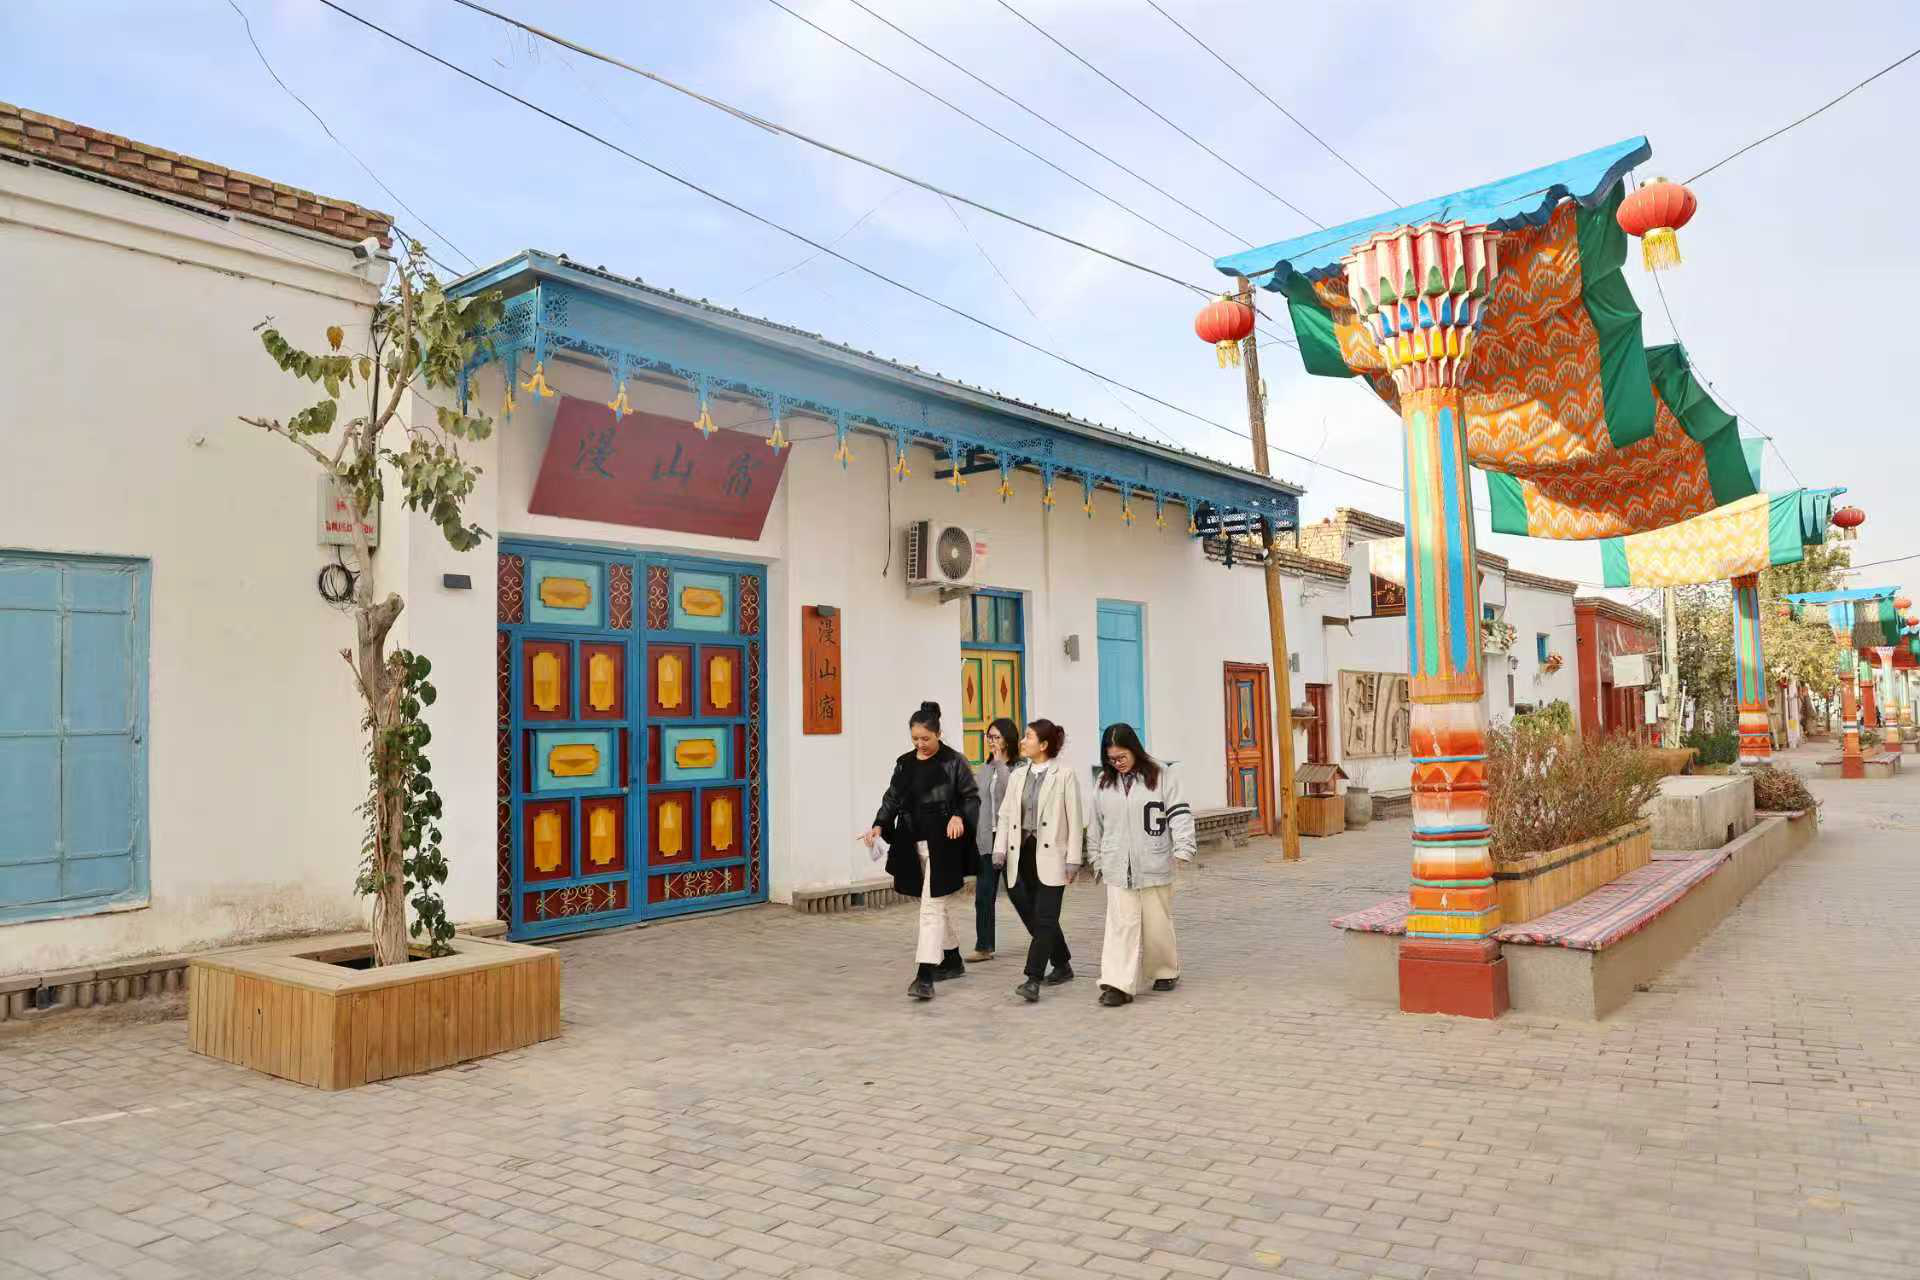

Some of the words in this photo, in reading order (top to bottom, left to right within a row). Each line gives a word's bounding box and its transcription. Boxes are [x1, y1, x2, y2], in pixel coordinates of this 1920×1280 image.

[818, 617, 837, 720] 漫山宿
[1144, 801, 1166, 836] G
